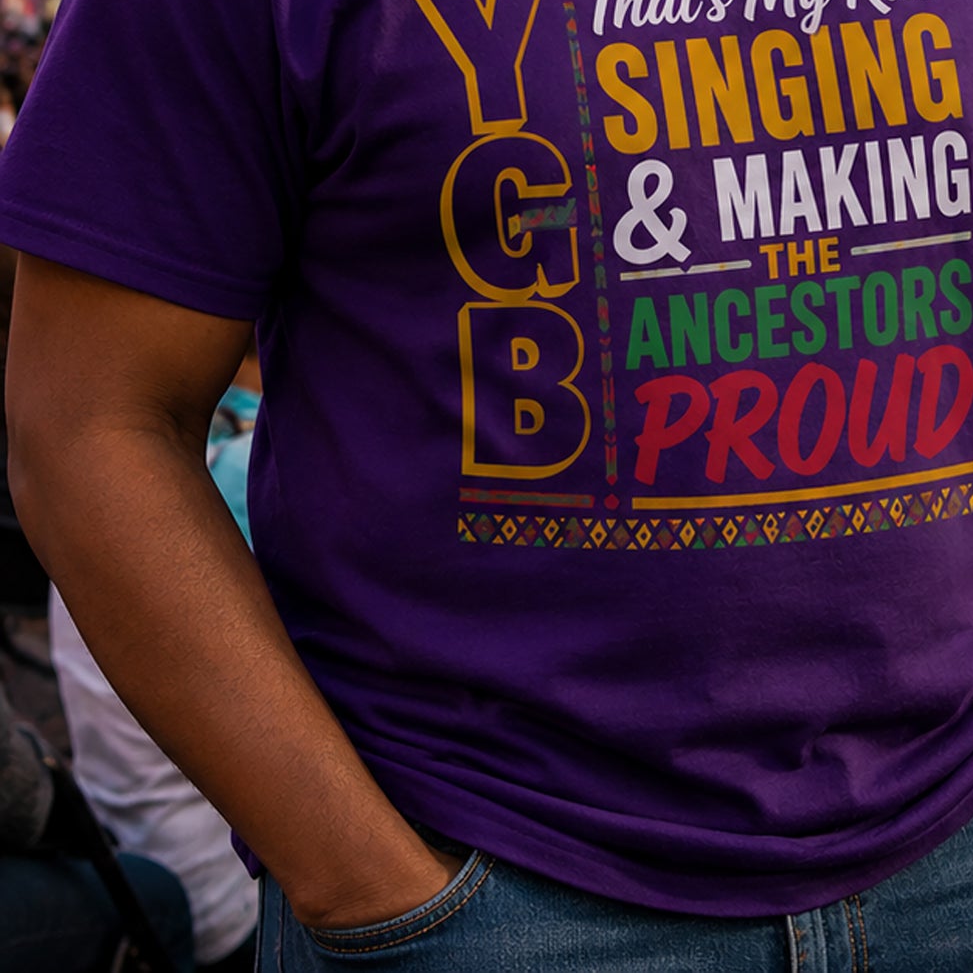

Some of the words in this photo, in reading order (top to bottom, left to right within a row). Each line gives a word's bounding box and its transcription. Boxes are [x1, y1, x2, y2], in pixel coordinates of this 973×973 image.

[597, 12, 963, 155] SINGING
[612, 158, 692, 265] &
[712, 130, 973, 243] MAKING
[759, 236, 842, 279] THE
[625, 258, 973, 370] ANCESTORS
